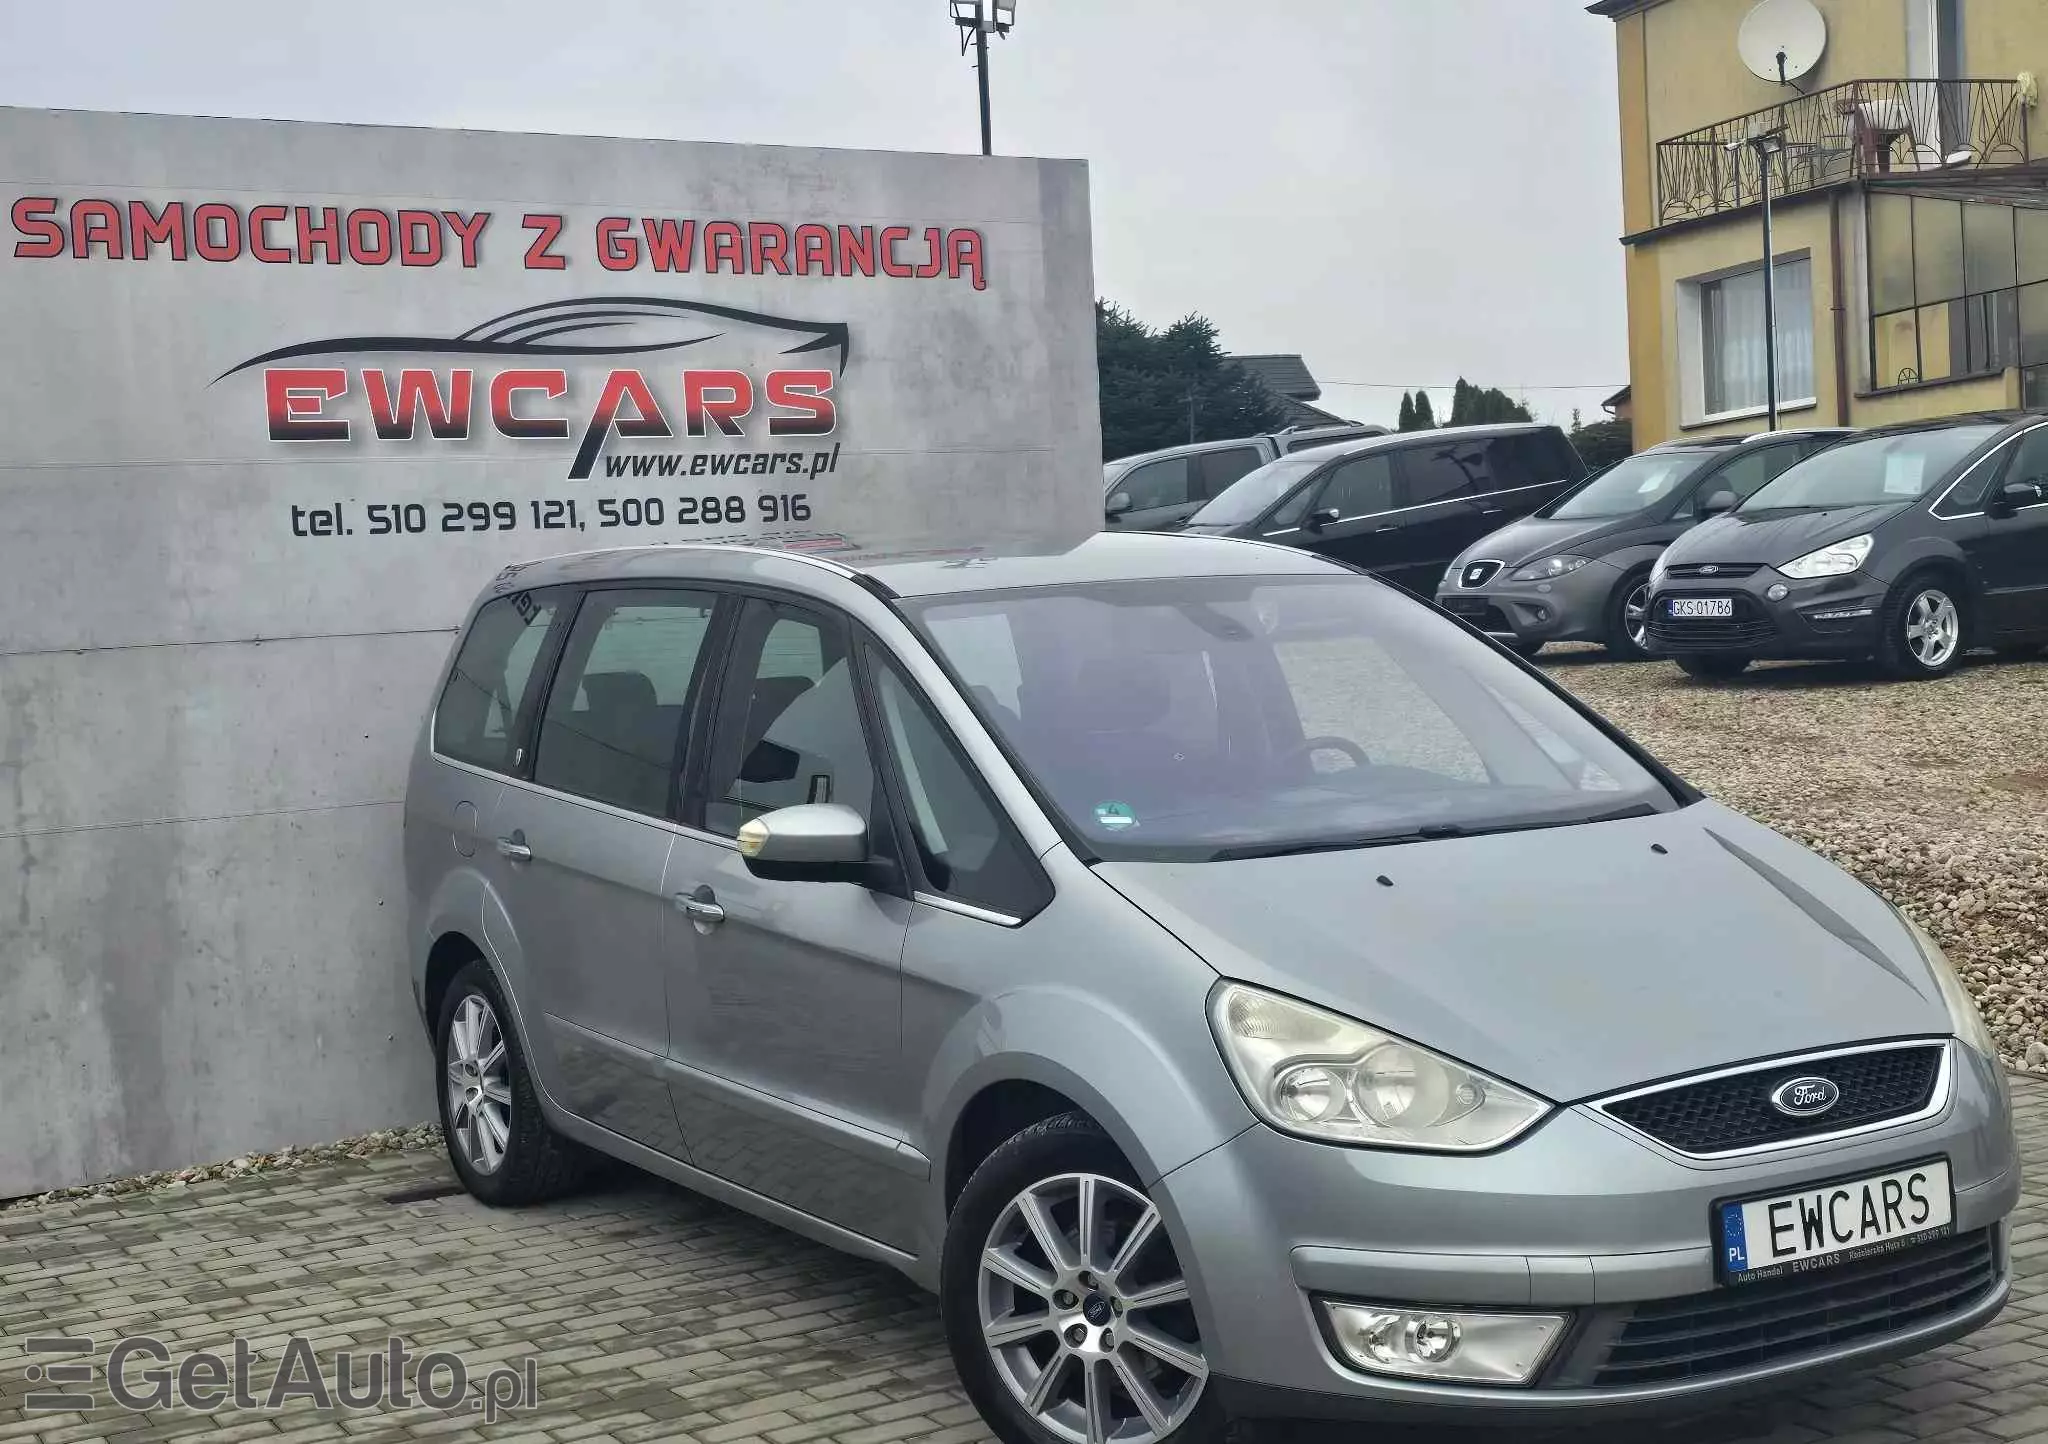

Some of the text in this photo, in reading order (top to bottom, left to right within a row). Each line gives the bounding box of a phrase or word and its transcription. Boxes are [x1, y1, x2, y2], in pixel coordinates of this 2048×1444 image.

[11, 197, 987, 291] SAMOCHODY Z GWARANCJĄ
[264, 367, 838, 481] EWCARS
[606, 442, 841, 480] www.ewcars.pl
[292, 494, 812, 537] tel. 510 299 121, 500 288 916
[1673, 601, 1694, 615] GKS
[1794, 1084, 1827, 1106] Ford
[1767, 1172, 1930, 1258] EWCARS
[1729, 1246, 1745, 1262] PL
[1792, 1253, 1841, 1273] EWCARS
